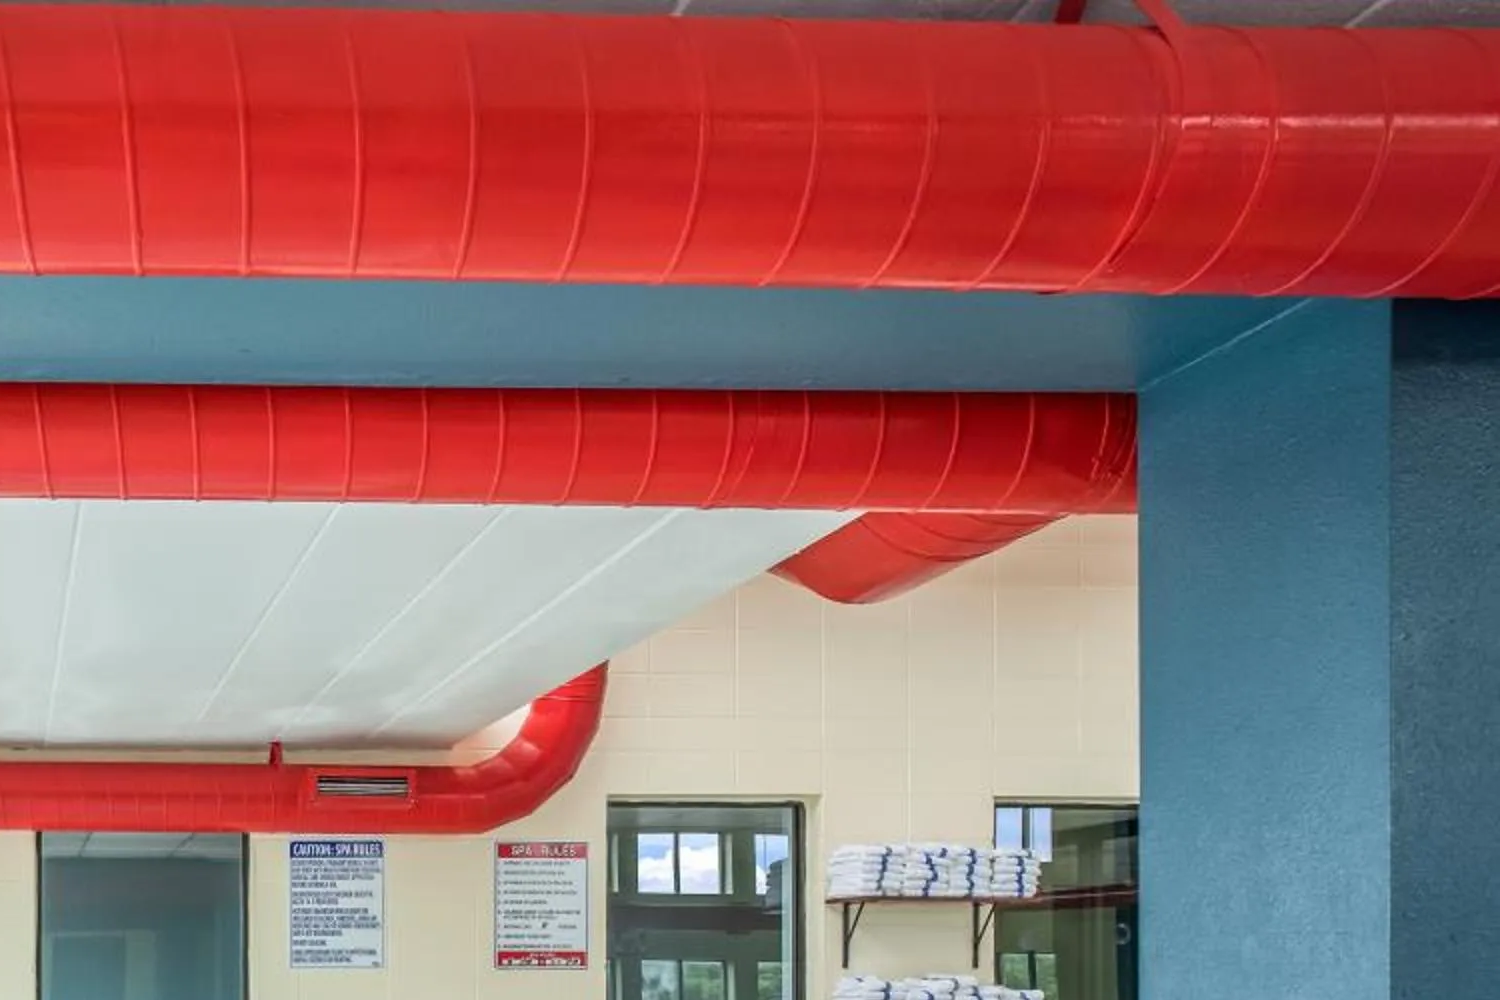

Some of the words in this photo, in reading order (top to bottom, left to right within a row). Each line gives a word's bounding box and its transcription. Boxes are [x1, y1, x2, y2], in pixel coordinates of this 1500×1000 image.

[336, 843, 351, 857] SPA
[353, 843, 381, 856] RULES
[511, 845, 533, 857] SPA
[541, 844, 577, 857] RULES
